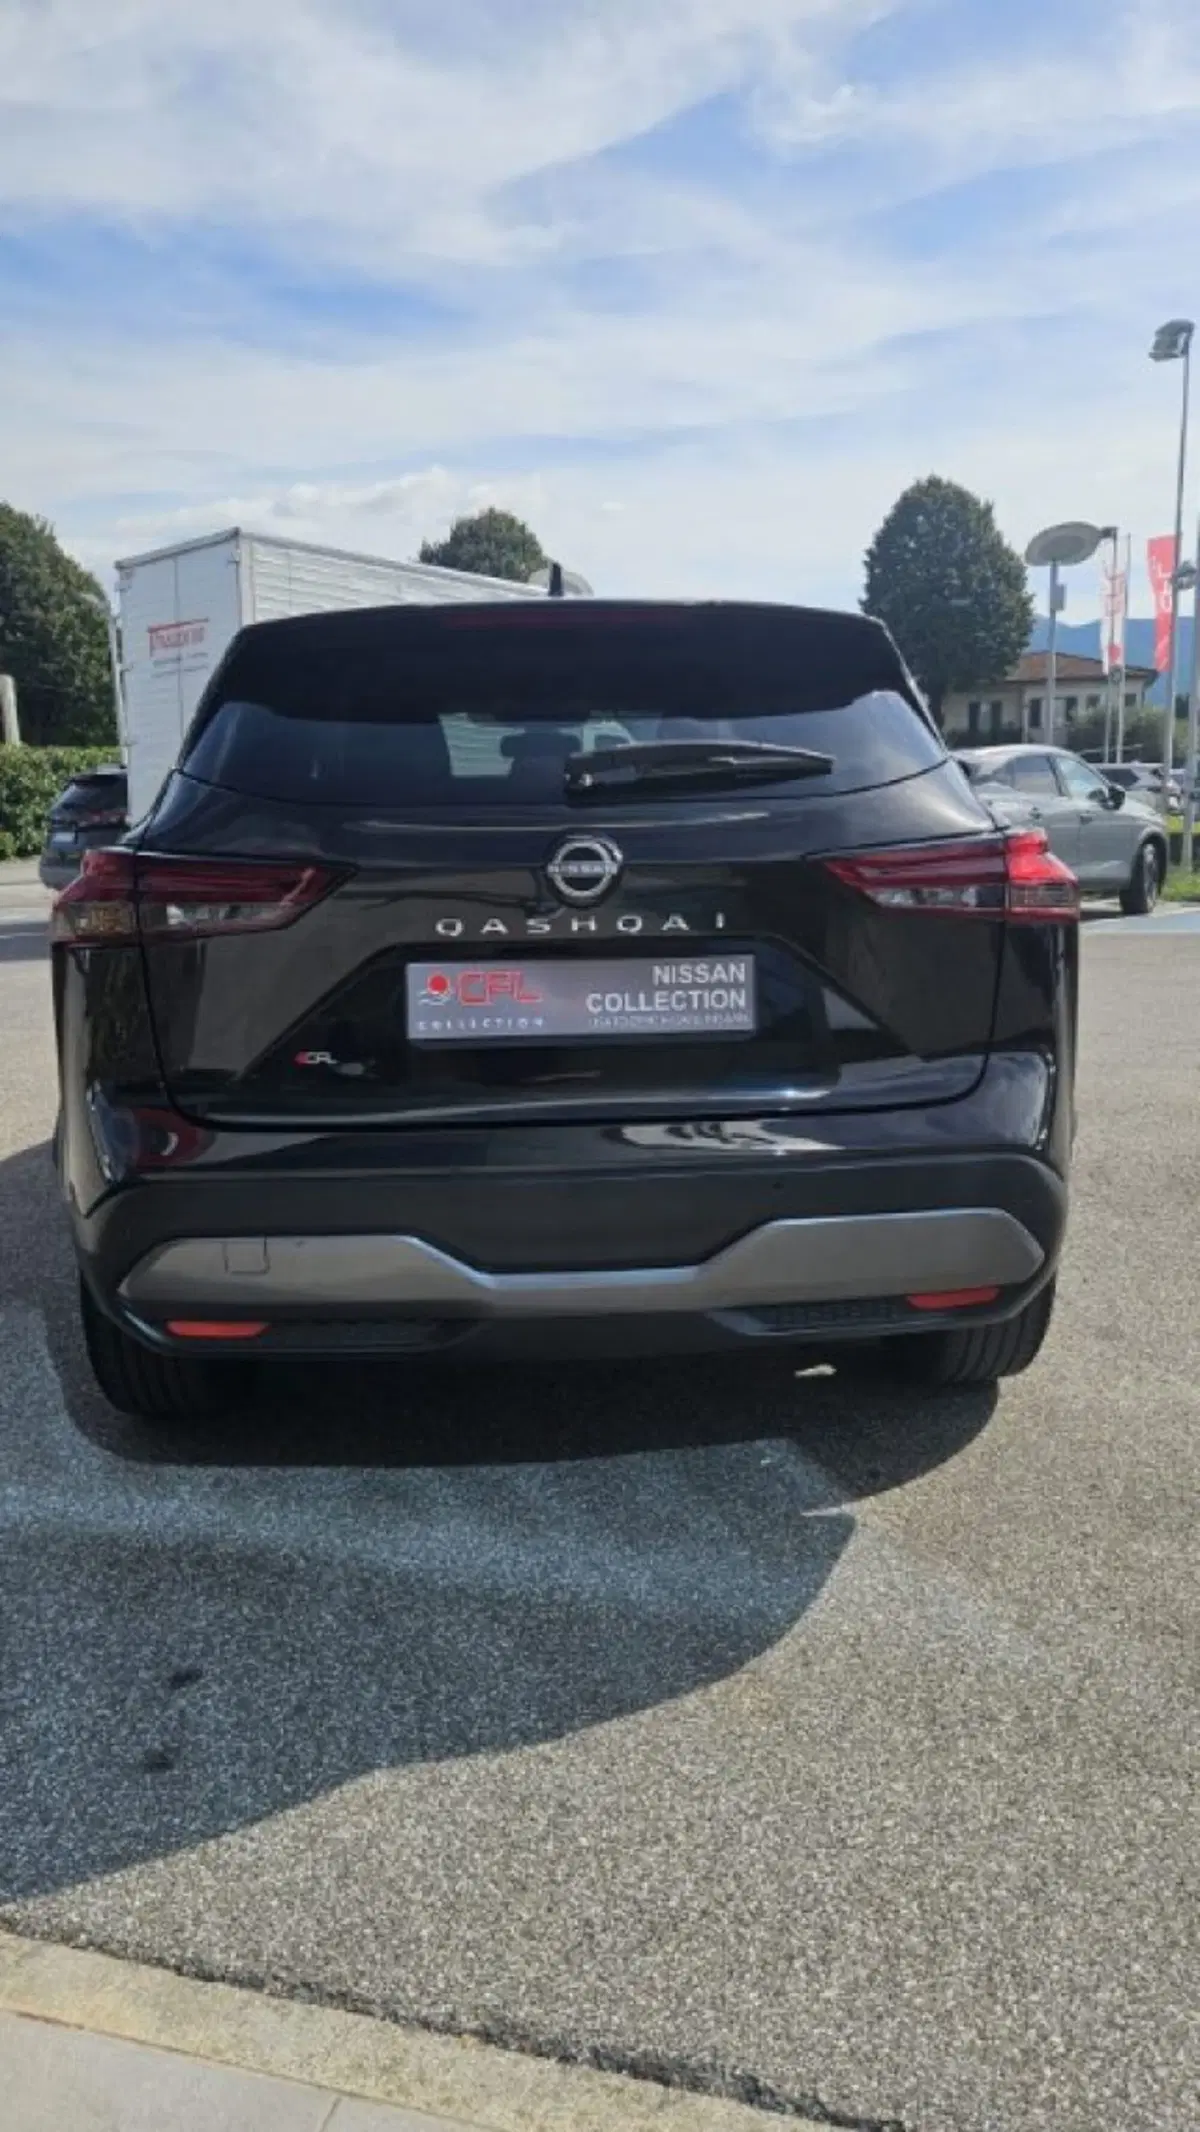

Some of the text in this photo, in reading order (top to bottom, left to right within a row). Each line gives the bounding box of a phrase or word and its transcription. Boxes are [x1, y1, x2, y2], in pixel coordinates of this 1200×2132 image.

[548, 863, 618, 874] NISSAN
[435, 912, 725, 936] QASHQAI
[653, 963, 746, 986] NISSAN
[585, 988, 746, 1014] COLLECTION
